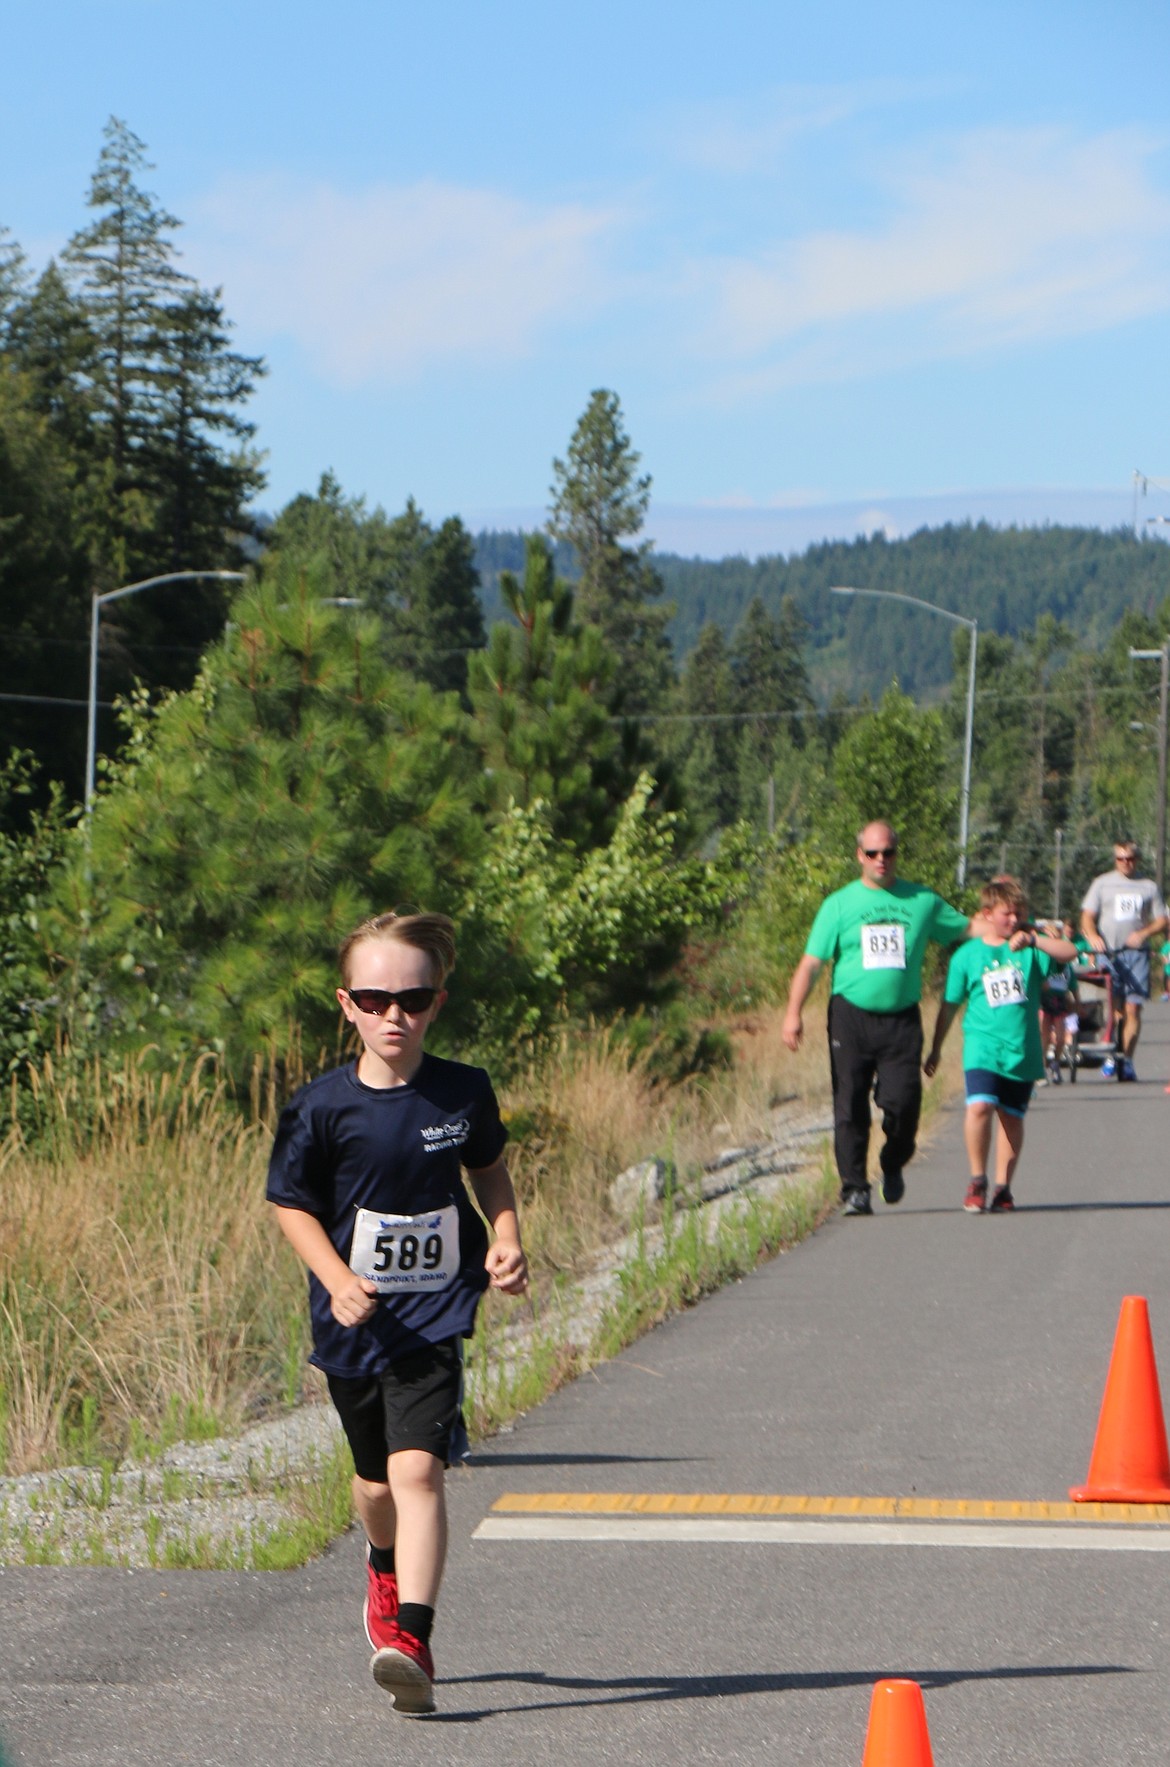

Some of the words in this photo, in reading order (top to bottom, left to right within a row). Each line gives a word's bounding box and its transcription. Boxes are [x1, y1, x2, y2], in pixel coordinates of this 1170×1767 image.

[870, 935, 899, 953] 835
[991, 978, 1021, 999] 834
[373, 1233, 442, 1271] 589
